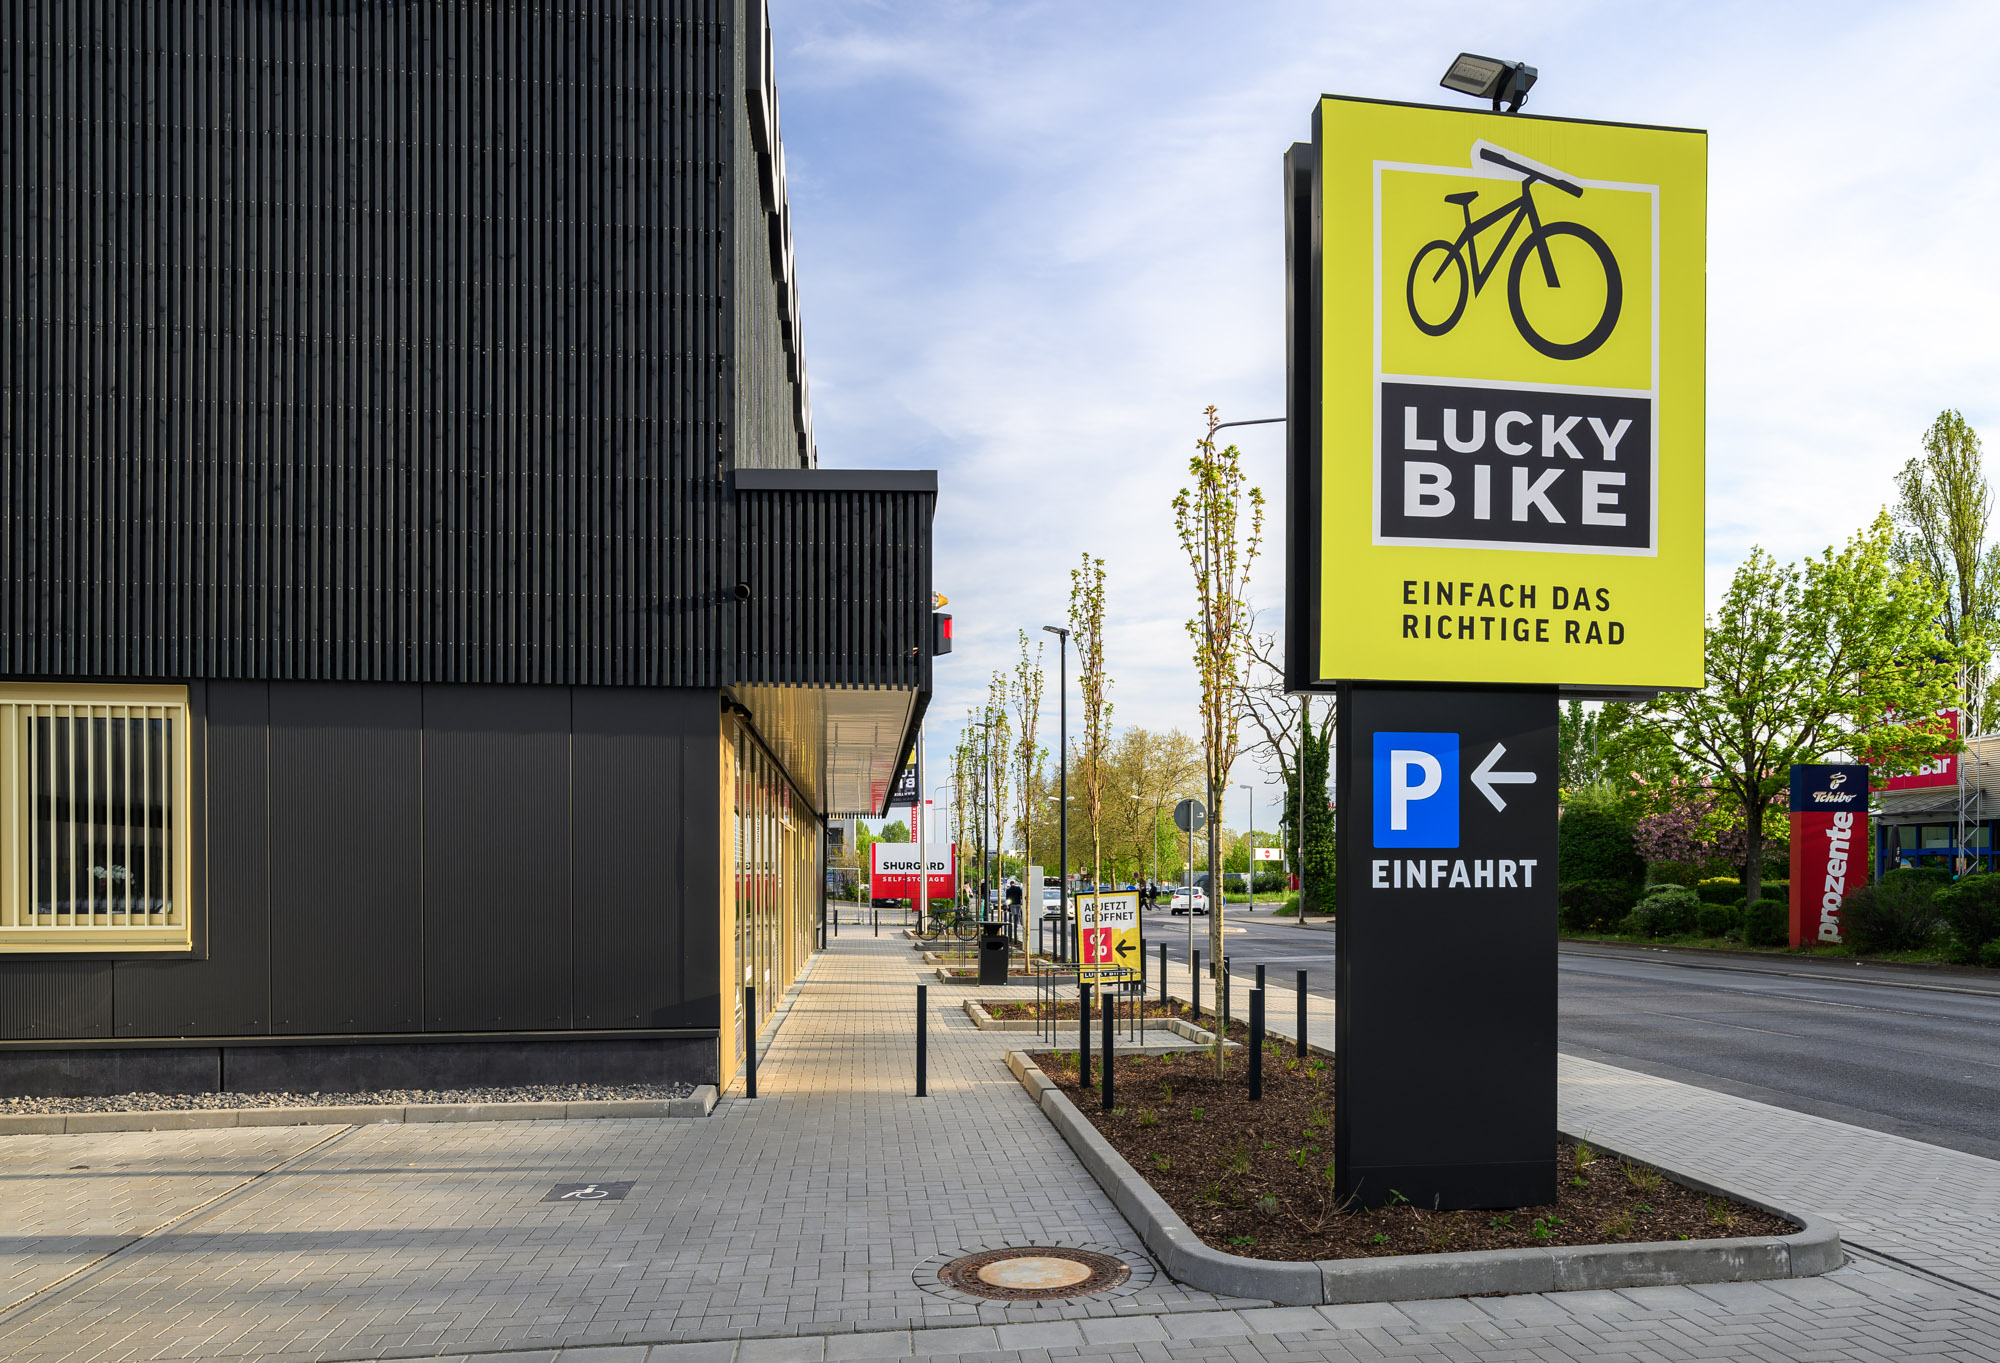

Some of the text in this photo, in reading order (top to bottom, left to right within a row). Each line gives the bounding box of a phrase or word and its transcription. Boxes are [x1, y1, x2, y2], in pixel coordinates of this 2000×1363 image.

[1404, 406, 1633, 461] LUCKY
[1404, 461, 1627, 527] BIKE
[1403, 580, 1611, 612] EINFACH DAS
[1402, 614, 1625, 645] RICHTIGE RAD
[1391, 750, 1442, 830] P
[1812, 791, 1857, 803] Tchibo
[883, 862, 945, 870] SHURGRD
[1372, 859, 1538, 888] EINFAHRT
[1817, 811, 1854, 944] prozente
